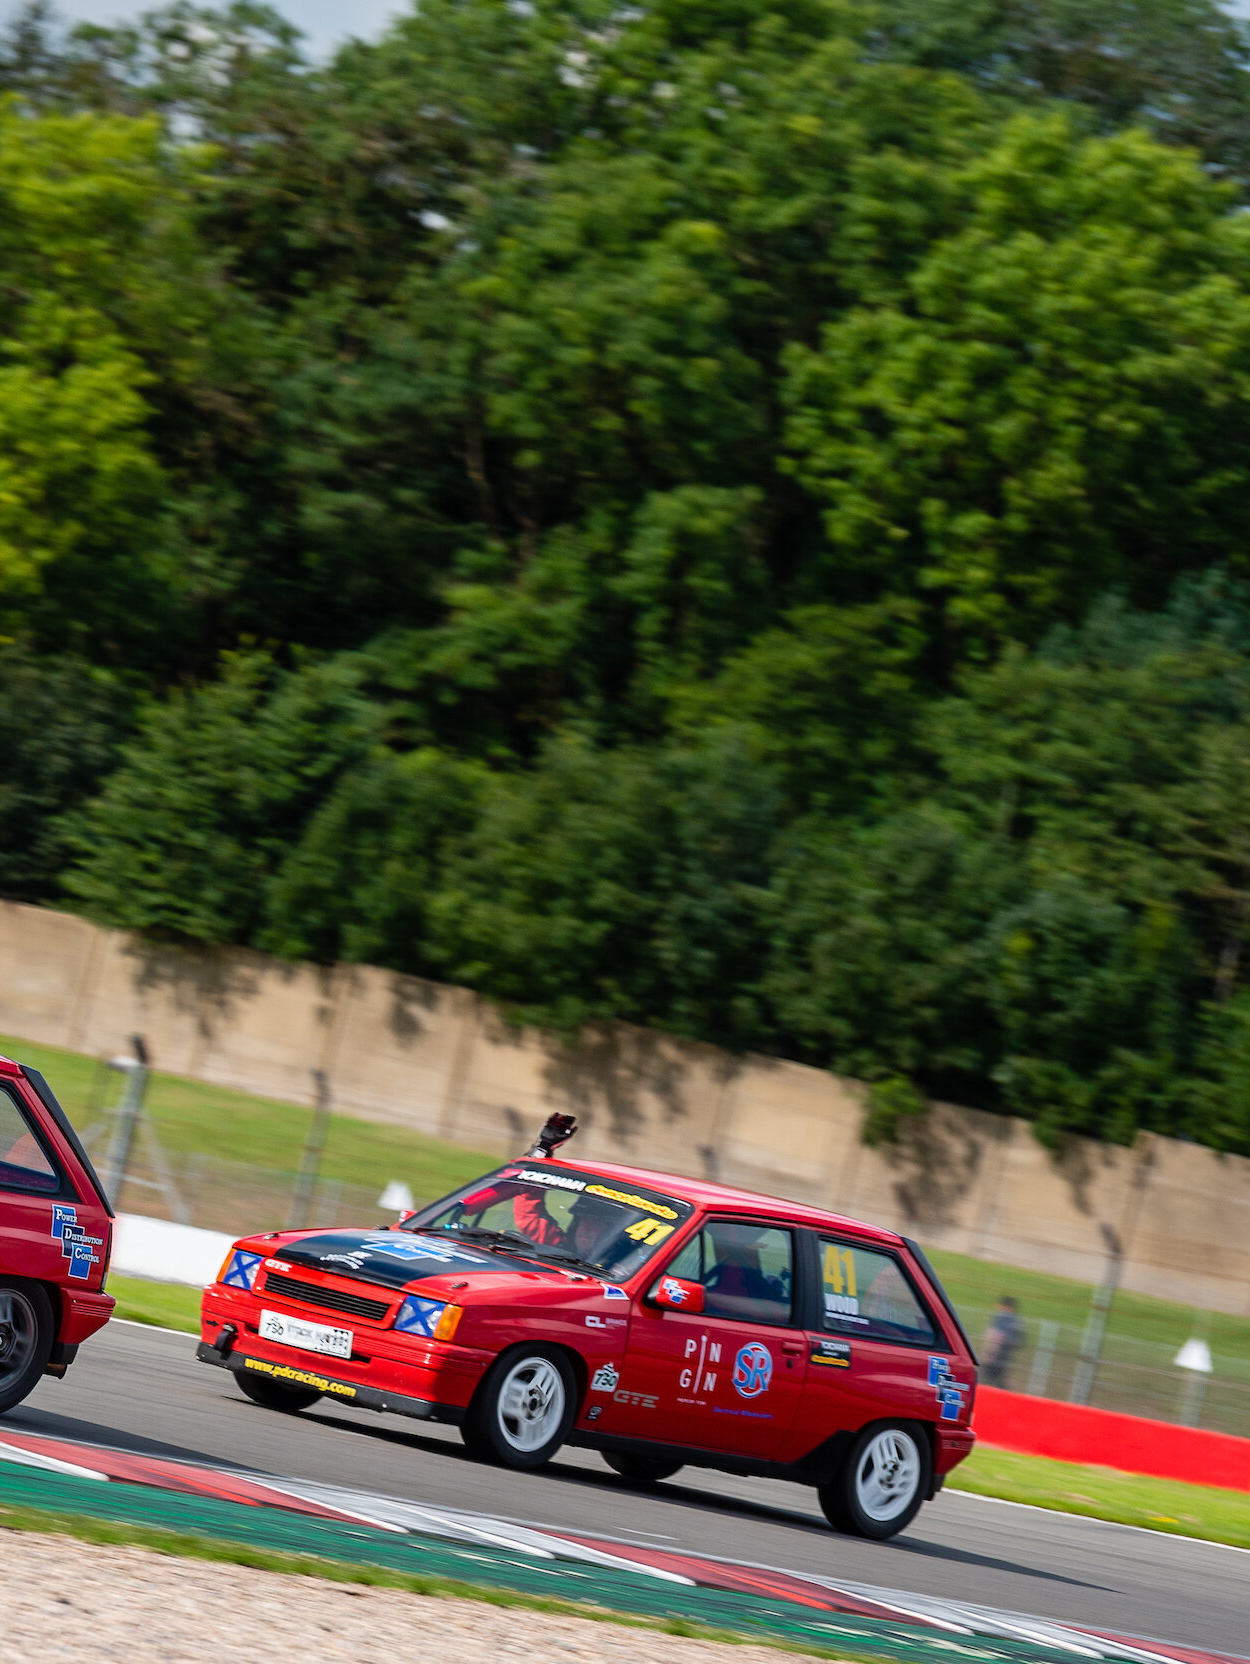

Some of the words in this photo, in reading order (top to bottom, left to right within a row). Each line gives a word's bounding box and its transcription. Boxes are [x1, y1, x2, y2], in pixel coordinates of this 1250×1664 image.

[623, 1217, 676, 1246] 41
[823, 1244, 858, 1297] 41
[244, 1357, 358, 1398] www.pdcracing.com
[731, 1346, 773, 1392] SR
